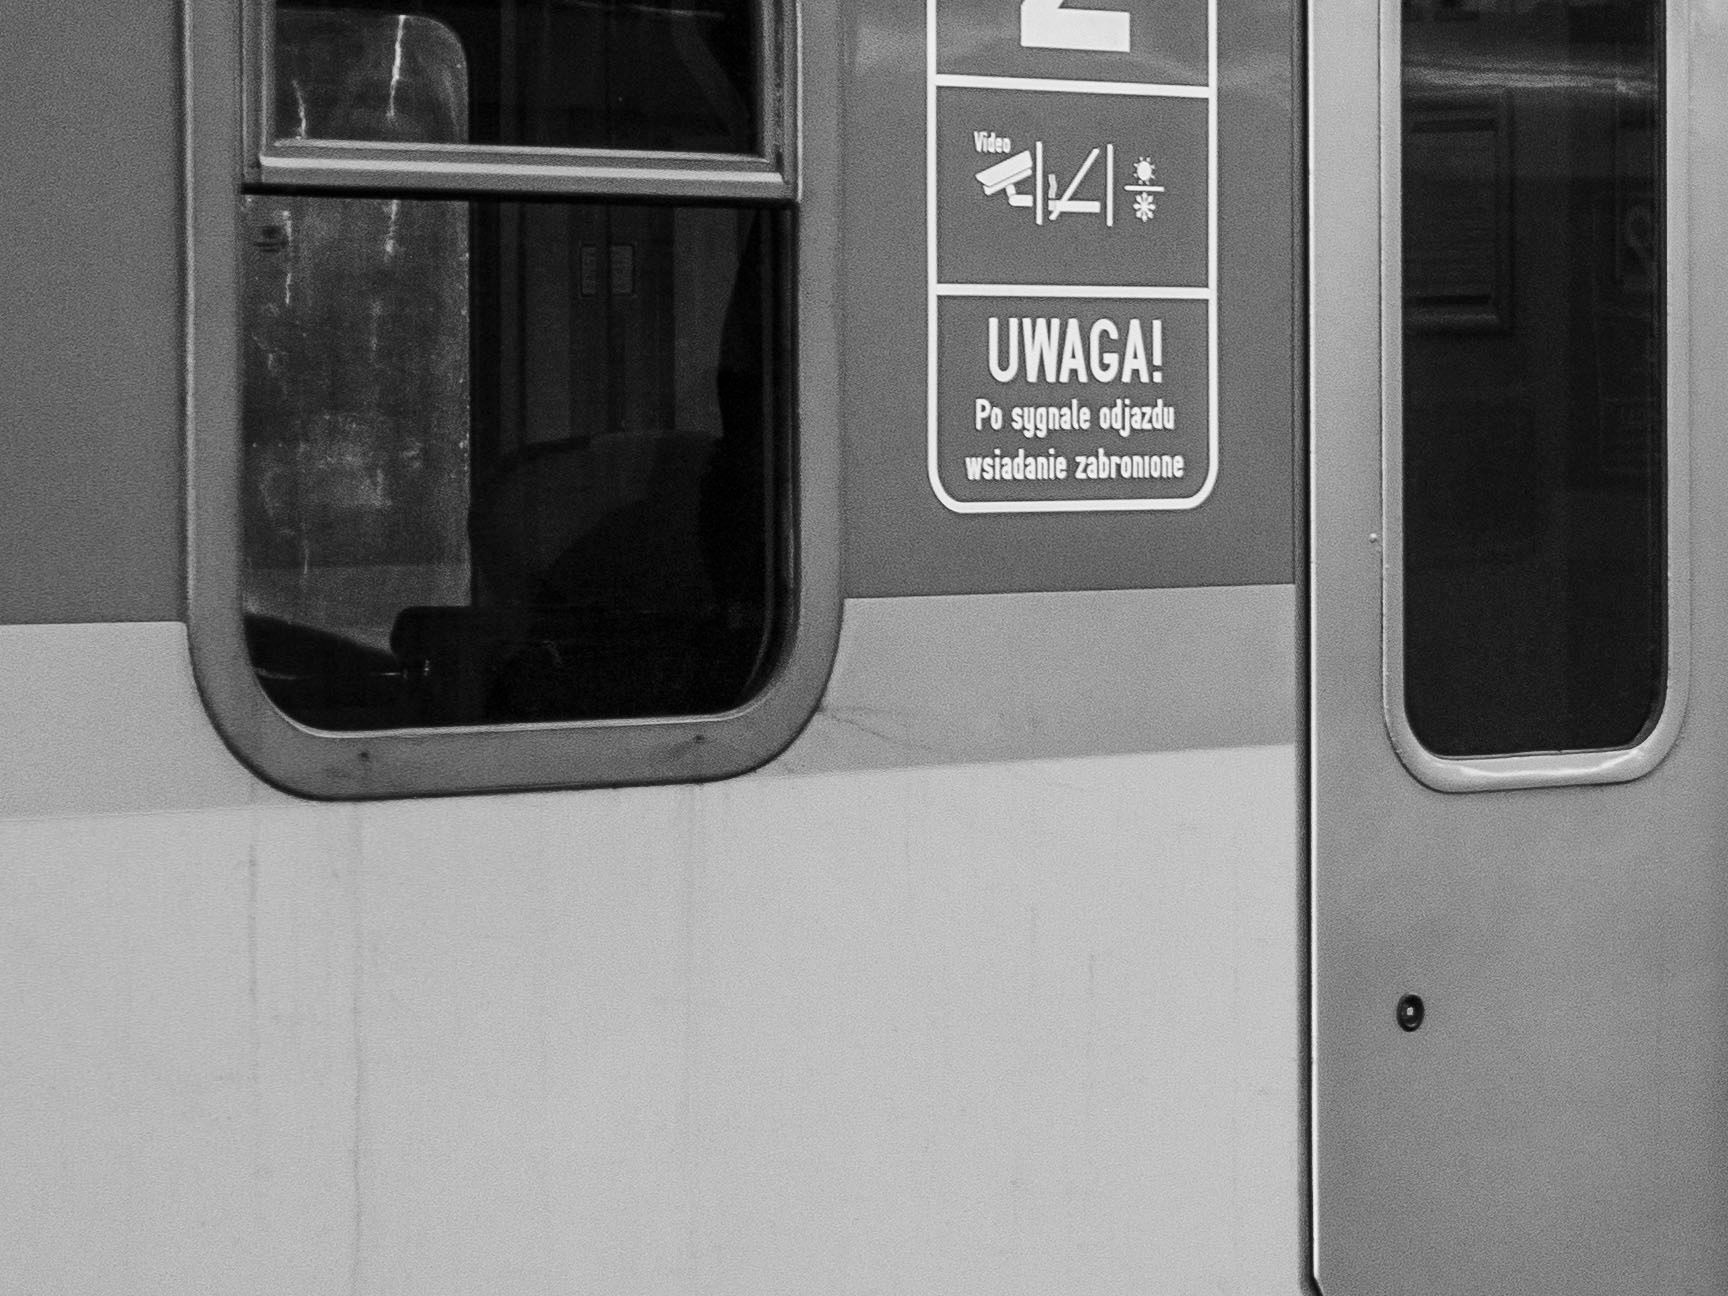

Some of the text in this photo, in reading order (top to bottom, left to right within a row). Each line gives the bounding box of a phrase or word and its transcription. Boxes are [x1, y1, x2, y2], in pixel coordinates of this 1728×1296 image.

[973, 131, 1012, 154] Video
[988, 316, 1163, 384] UWAGA!
[975, 398, 1176, 439] Po sygnale odjazdu
[965, 447, 1185, 481] wsiadanie zabronione
